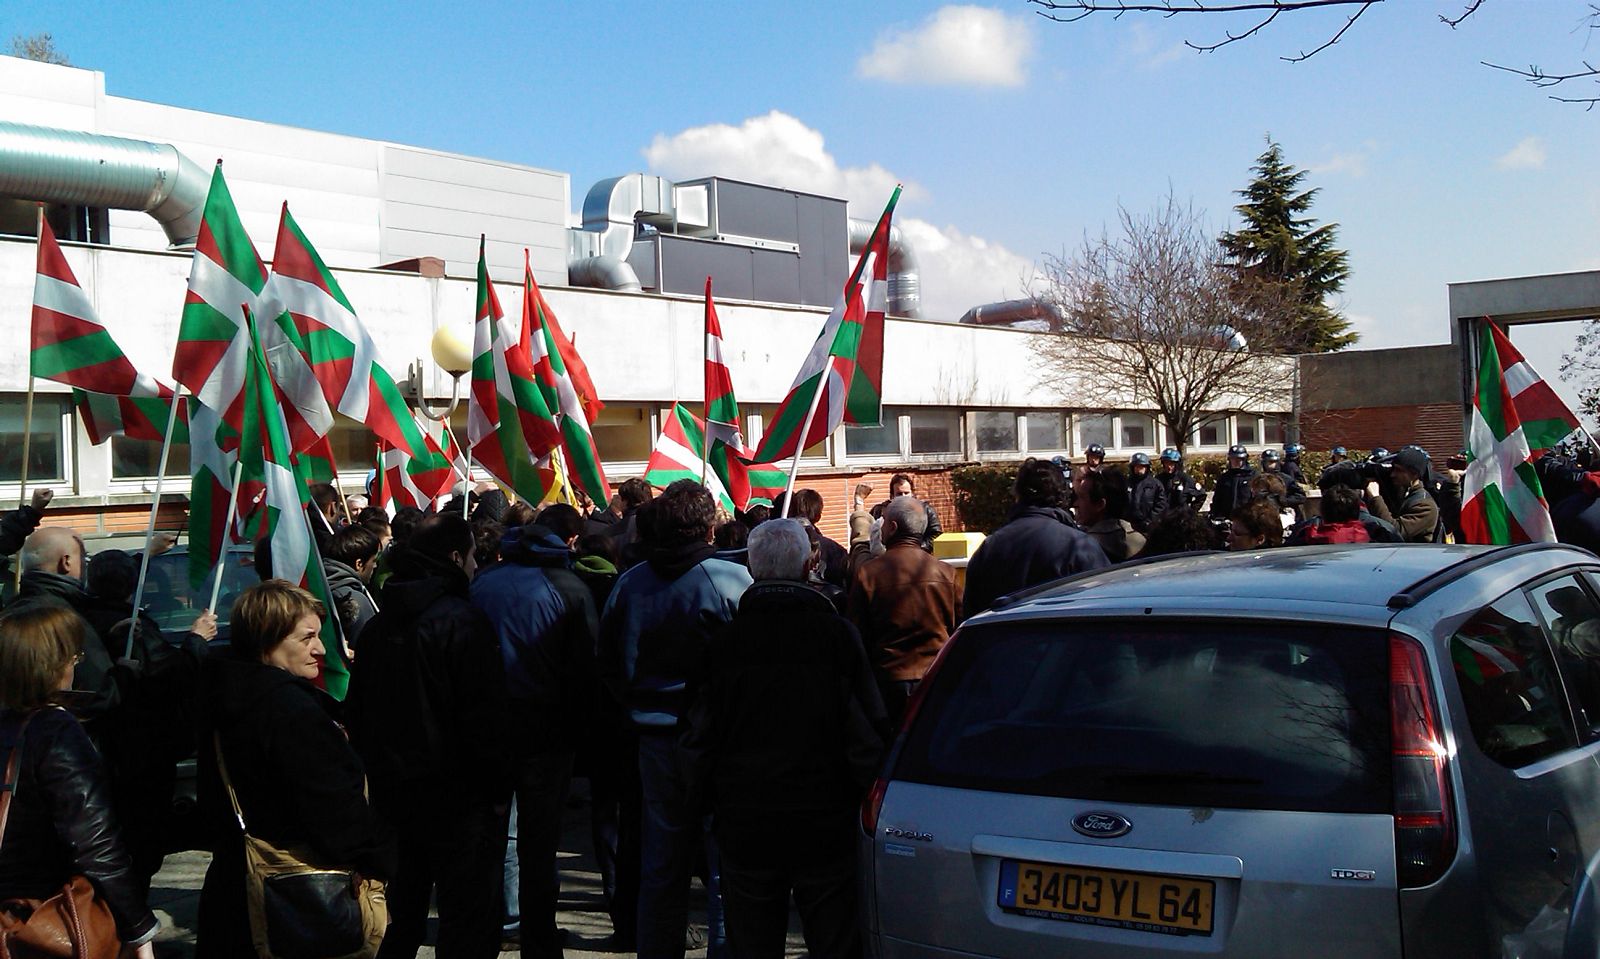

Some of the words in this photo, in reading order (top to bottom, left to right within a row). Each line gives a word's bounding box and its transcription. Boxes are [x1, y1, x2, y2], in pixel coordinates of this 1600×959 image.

[1083, 815, 1115, 830] Ford
[885, 827, 934, 841] FOCUS
[1005, 889, 1012, 899] F
[1022, 869, 1102, 913] 3403
[1110, 878, 1151, 919] YL
[1158, 884, 1202, 925] 64
